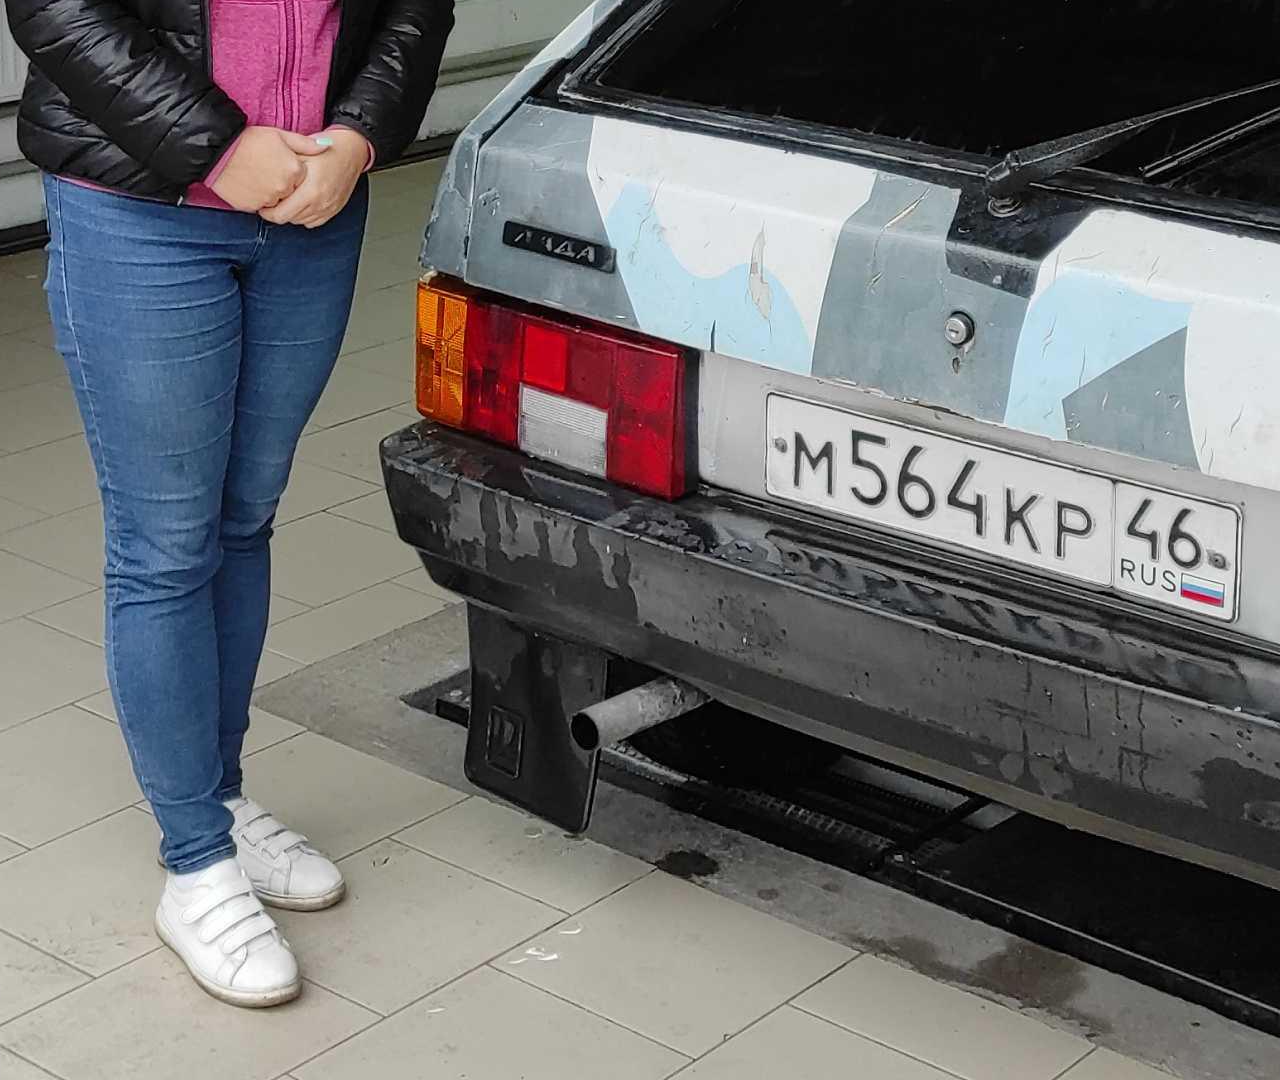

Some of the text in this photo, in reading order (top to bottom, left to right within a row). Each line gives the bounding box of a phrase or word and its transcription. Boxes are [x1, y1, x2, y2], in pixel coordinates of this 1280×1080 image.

[793, 429, 1202, 570] М564КР 46
[1121, 557, 1176, 593] RUS
